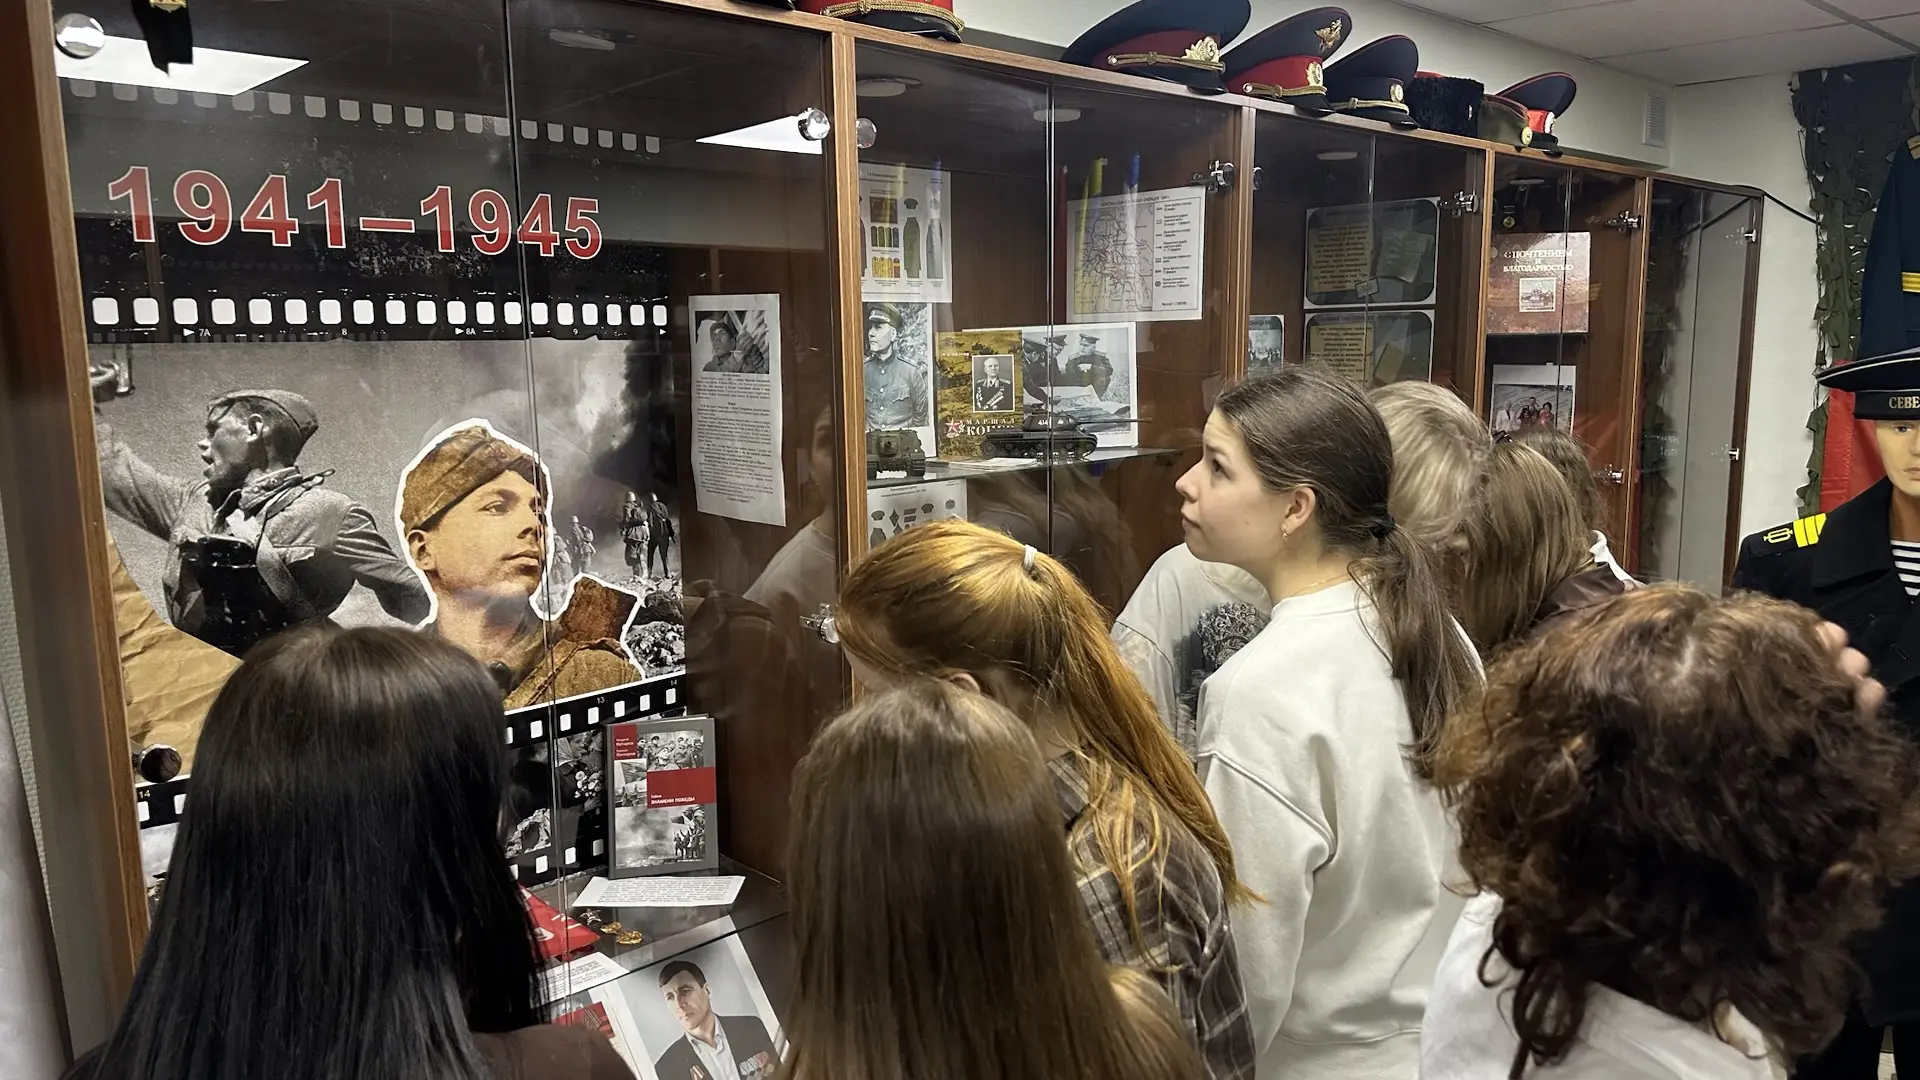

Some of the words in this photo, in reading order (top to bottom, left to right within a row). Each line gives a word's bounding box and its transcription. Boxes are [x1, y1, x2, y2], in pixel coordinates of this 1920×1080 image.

[198, 328, 211, 337] 7A
[341, 328, 348, 336] 8
[572, 328, 579, 336] 9
[139, 790, 150, 798] 14
